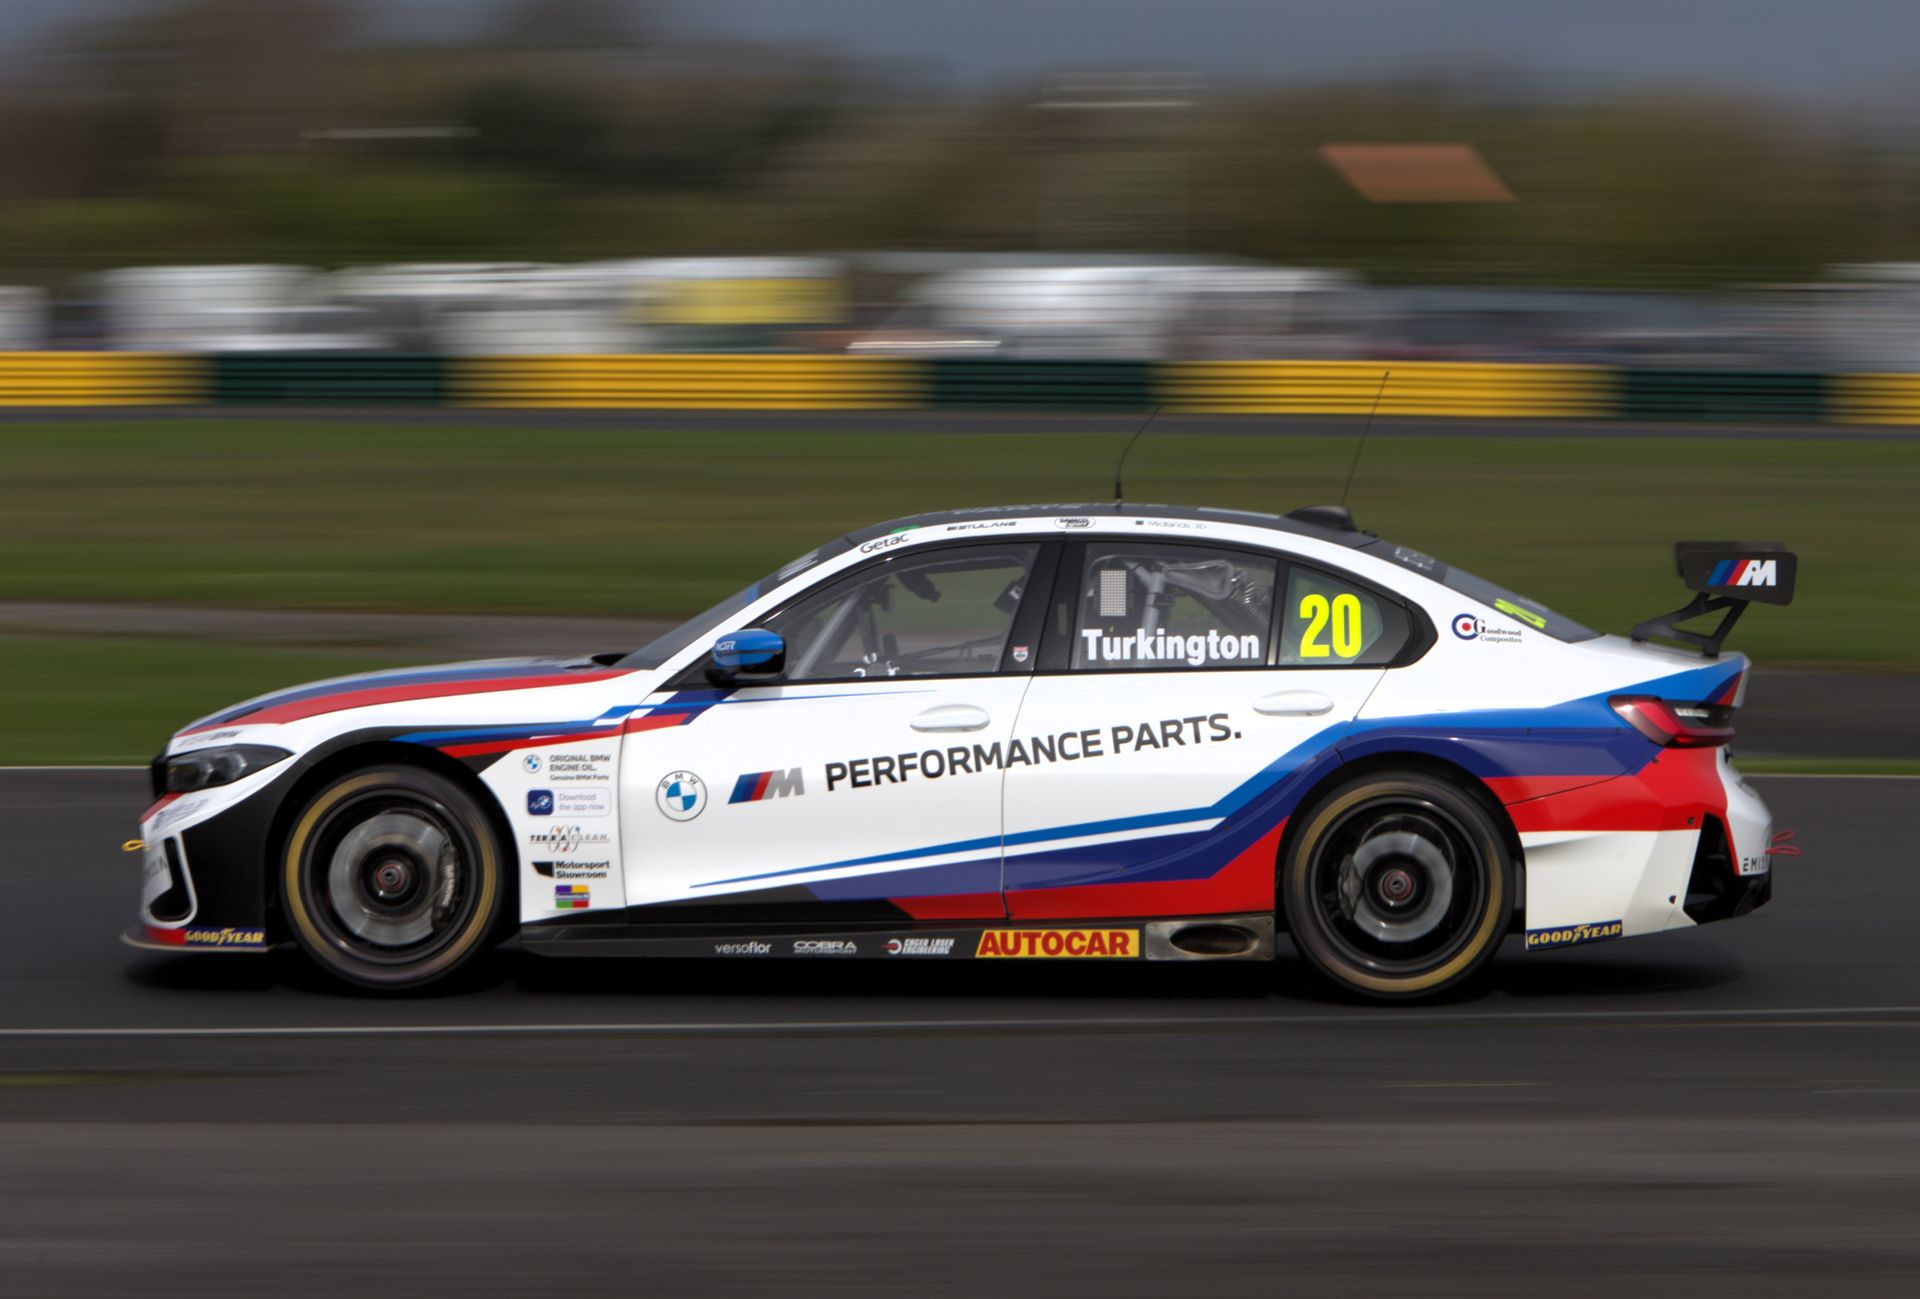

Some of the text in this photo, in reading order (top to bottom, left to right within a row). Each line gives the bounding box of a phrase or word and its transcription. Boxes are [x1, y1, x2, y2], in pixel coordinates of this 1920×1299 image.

[860, 532, 910, 554] Getac
[1299, 593, 1362, 659] 20
[1480, 635, 1522, 643] Composites
[1081, 627, 1260, 666] Turkington
[824, 713, 1242, 792] PERFORMANCE PARTS.
[549, 754, 611, 762] ORIGINAL BMW
[549, 763, 598, 772] ENGINE OIL.
[558, 793, 597, 801] Download
[555, 860, 610, 870] Motorsport
[555, 870, 607, 878] Showroom
[714, 940, 772, 954] versoflor
[793, 940, 858, 950] COBRA
[978, 931, 1130, 957] AUTOCAR
